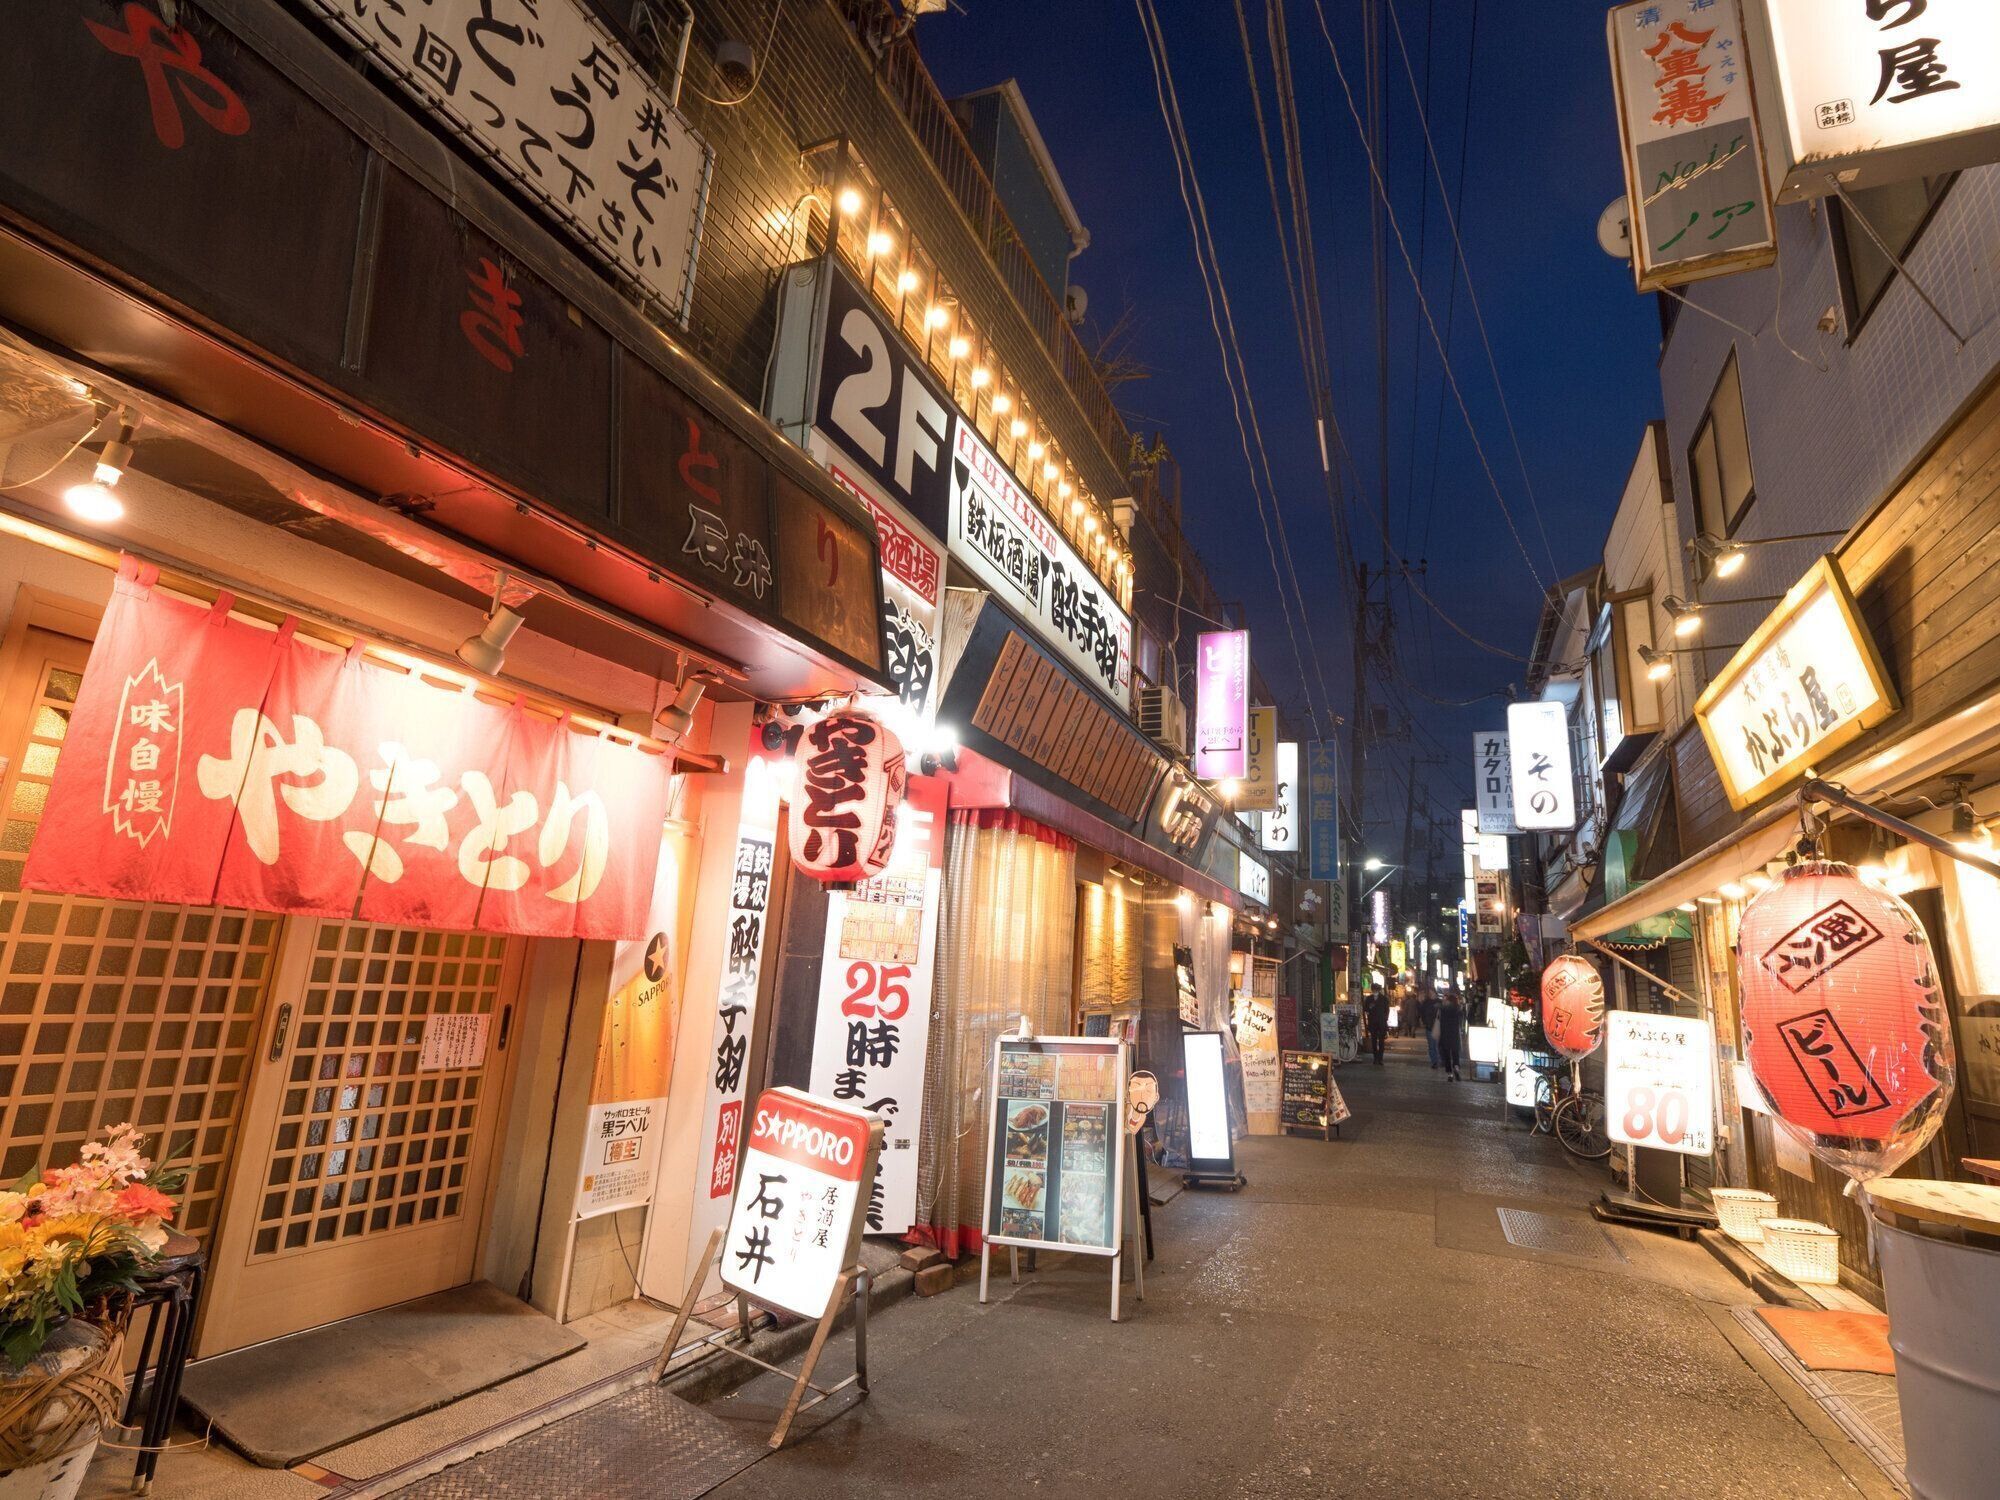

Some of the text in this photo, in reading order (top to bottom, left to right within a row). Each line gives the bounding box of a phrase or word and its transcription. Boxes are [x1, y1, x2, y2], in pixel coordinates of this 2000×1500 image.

[1643, 21, 1727, 125] 八重寿
[1716, 38, 1738, 84] やえす
[1658, 201, 1755, 252] ノア
[830, 308, 948, 496] 2F
[682, 503, 772, 599] 石井
[967, 489, 1039, 602] 鉄板酒場
[120, 699, 177, 813] 味自慢
[1742, 665, 1838, 777] かぶら屋
[197, 707, 608, 903] やきとり
[803, 717, 877, 869] やきとり
[1483, 738, 1501, 809] カタロー
[1528, 752, 1559, 815] その
[1243, 1014, 1266, 1032] Hour
[1628, 1027, 1687, 1045] かぶら屋
[1788, 1018, 1867, 1111] ビール
[603, 1106, 651, 1119] サッポロ生ビール
[1515, 1061, 1527, 1098] その
[601, 1117, 649, 1138] 黒ラベル
[712, 1108, 739, 1191] 別館
[735, 1173, 788, 1285] 石井
[812, 1186, 838, 1249] 居酒屋
